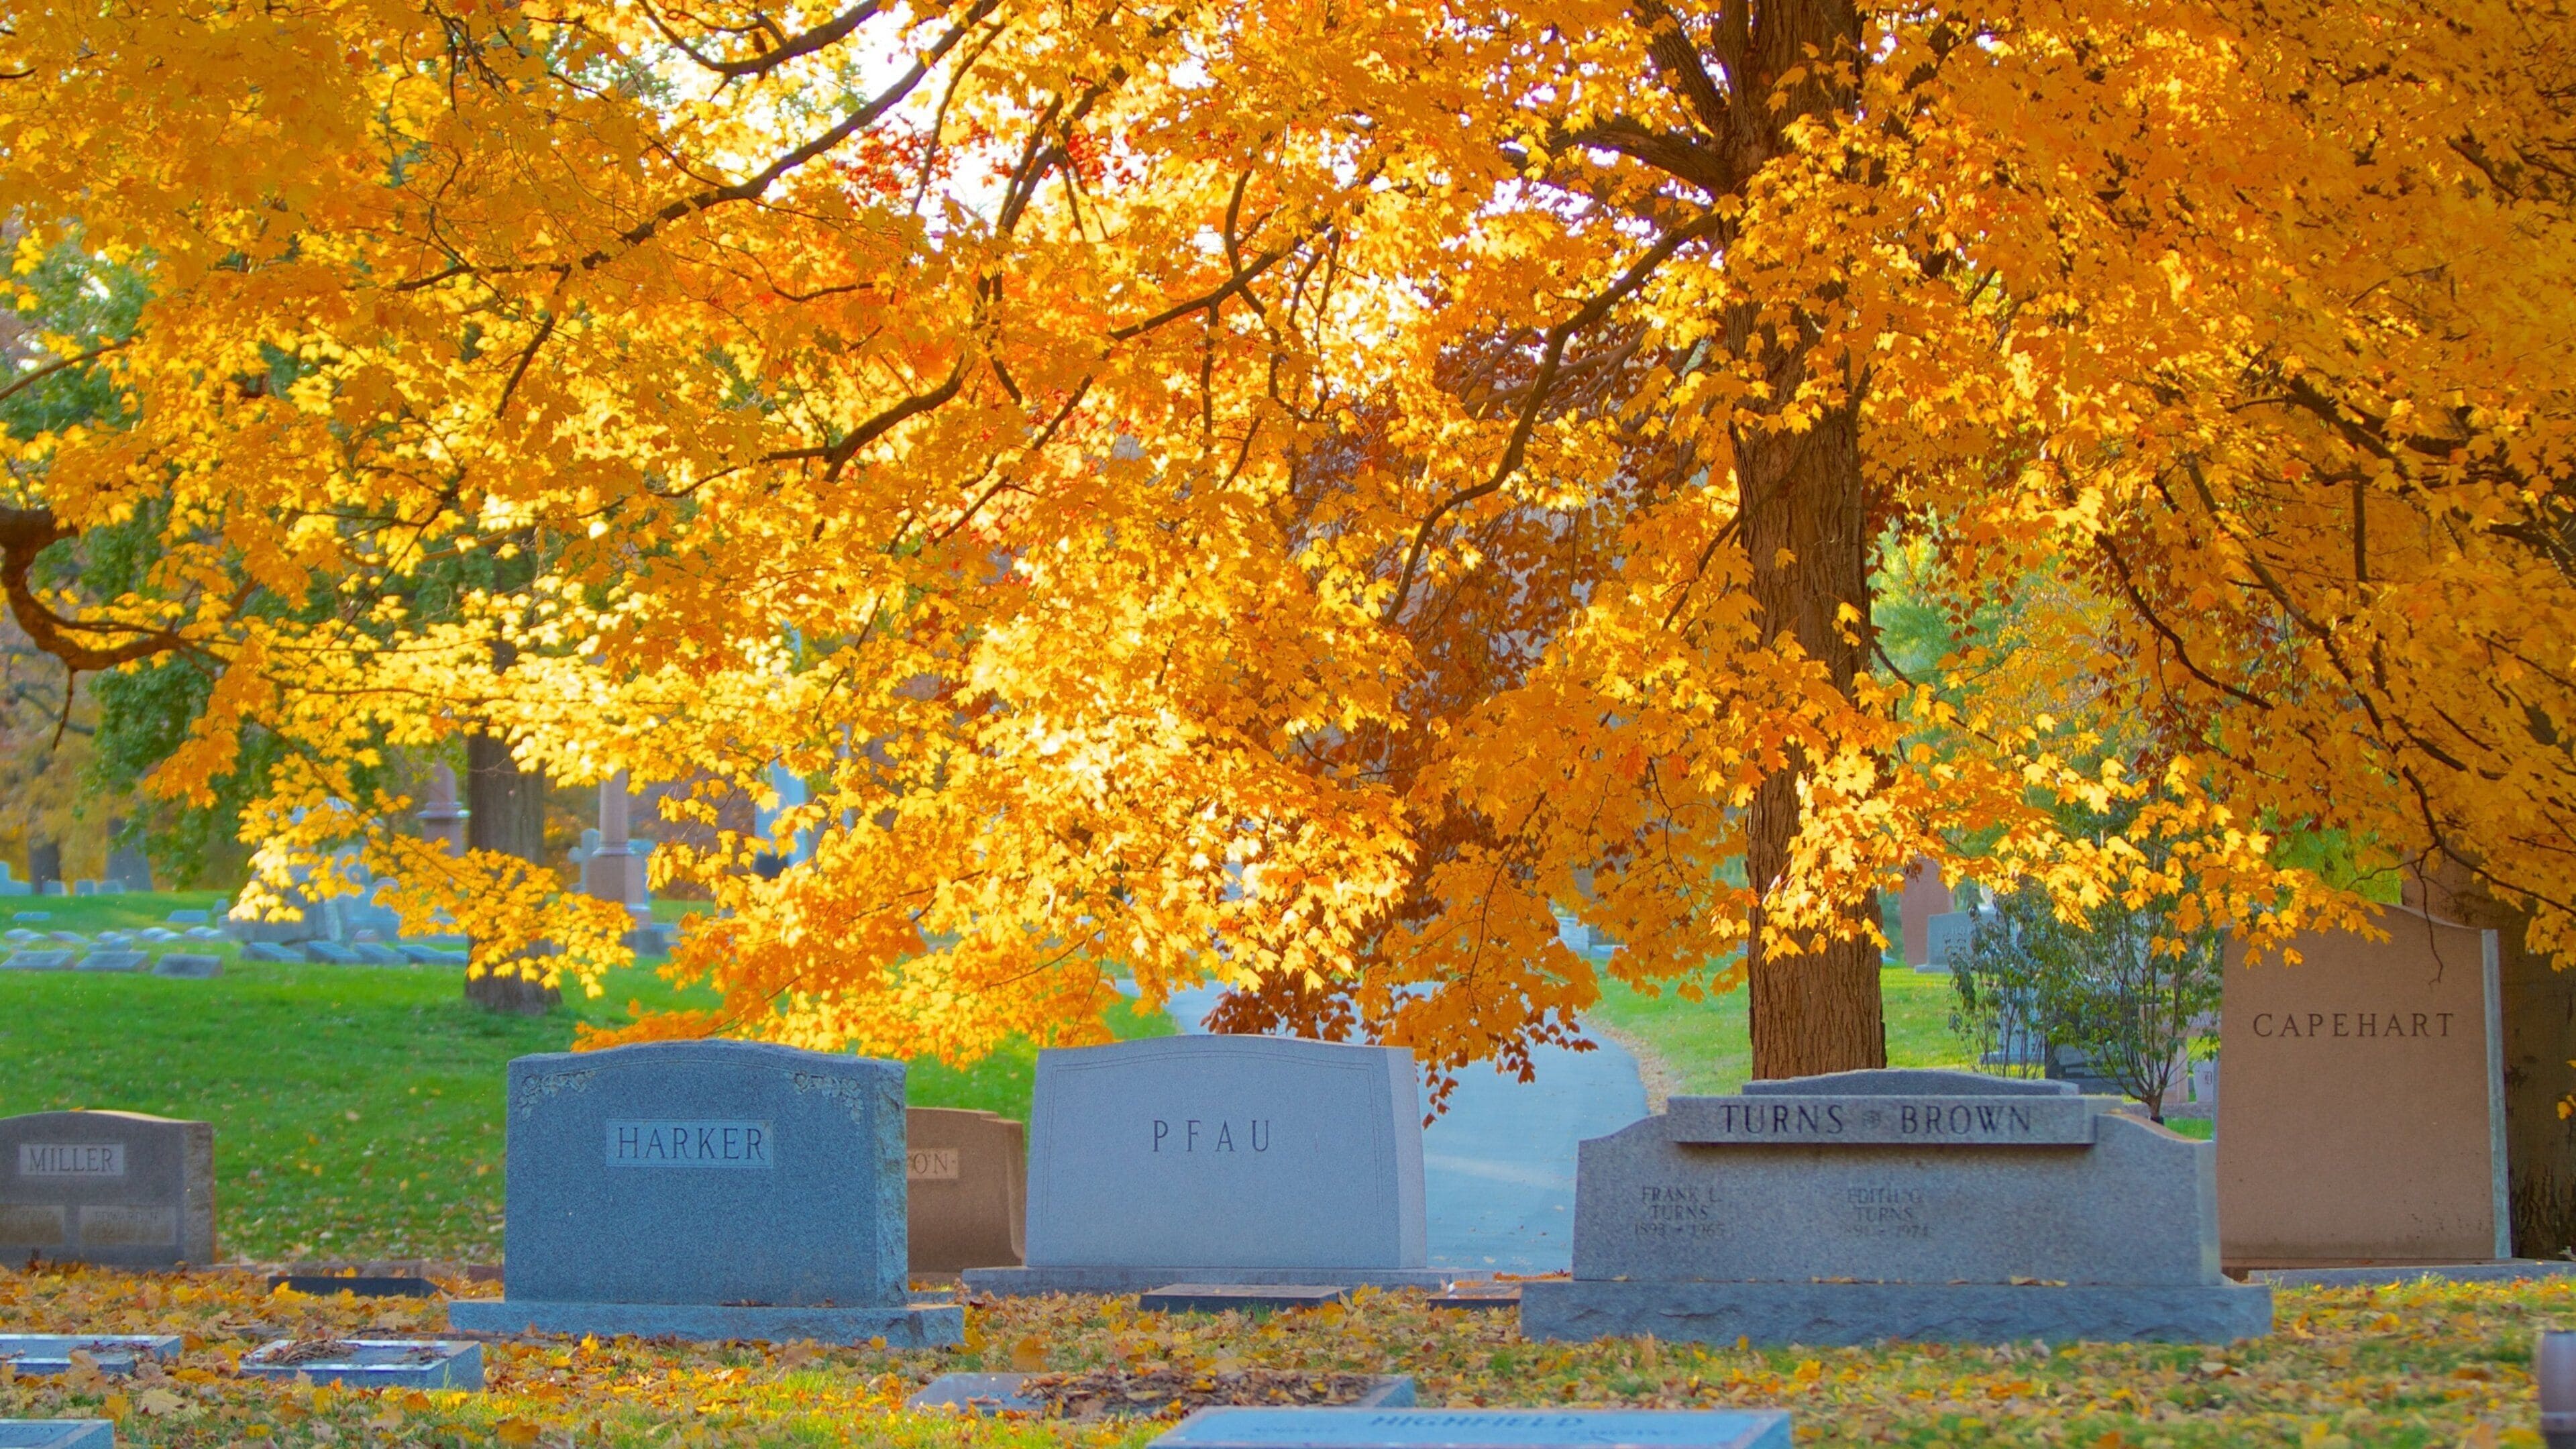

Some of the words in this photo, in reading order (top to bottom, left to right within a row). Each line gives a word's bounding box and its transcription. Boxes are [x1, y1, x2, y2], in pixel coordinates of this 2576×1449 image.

[2252, 1012, 2455, 1038] CAPEHART
[1719, 1104, 1844, 1134] TURNS
[1900, 1104, 2031, 1134] BROWN
[617, 1126, 766, 1160] HARKER
[1152, 1119, 1271, 1152] PFAU
[29, 1147, 114, 1173] MILLER
[908, 1152, 948, 1174] ON
[1642, 1185, 1699, 1203] FRANK
[1847, 1187, 1899, 1203] EDITH
[1651, 1204, 1709, 1222] TURNS
[1854, 1205, 1914, 1222] TURNS
[1370, 1414, 1585, 1428] HIGHFIELD
